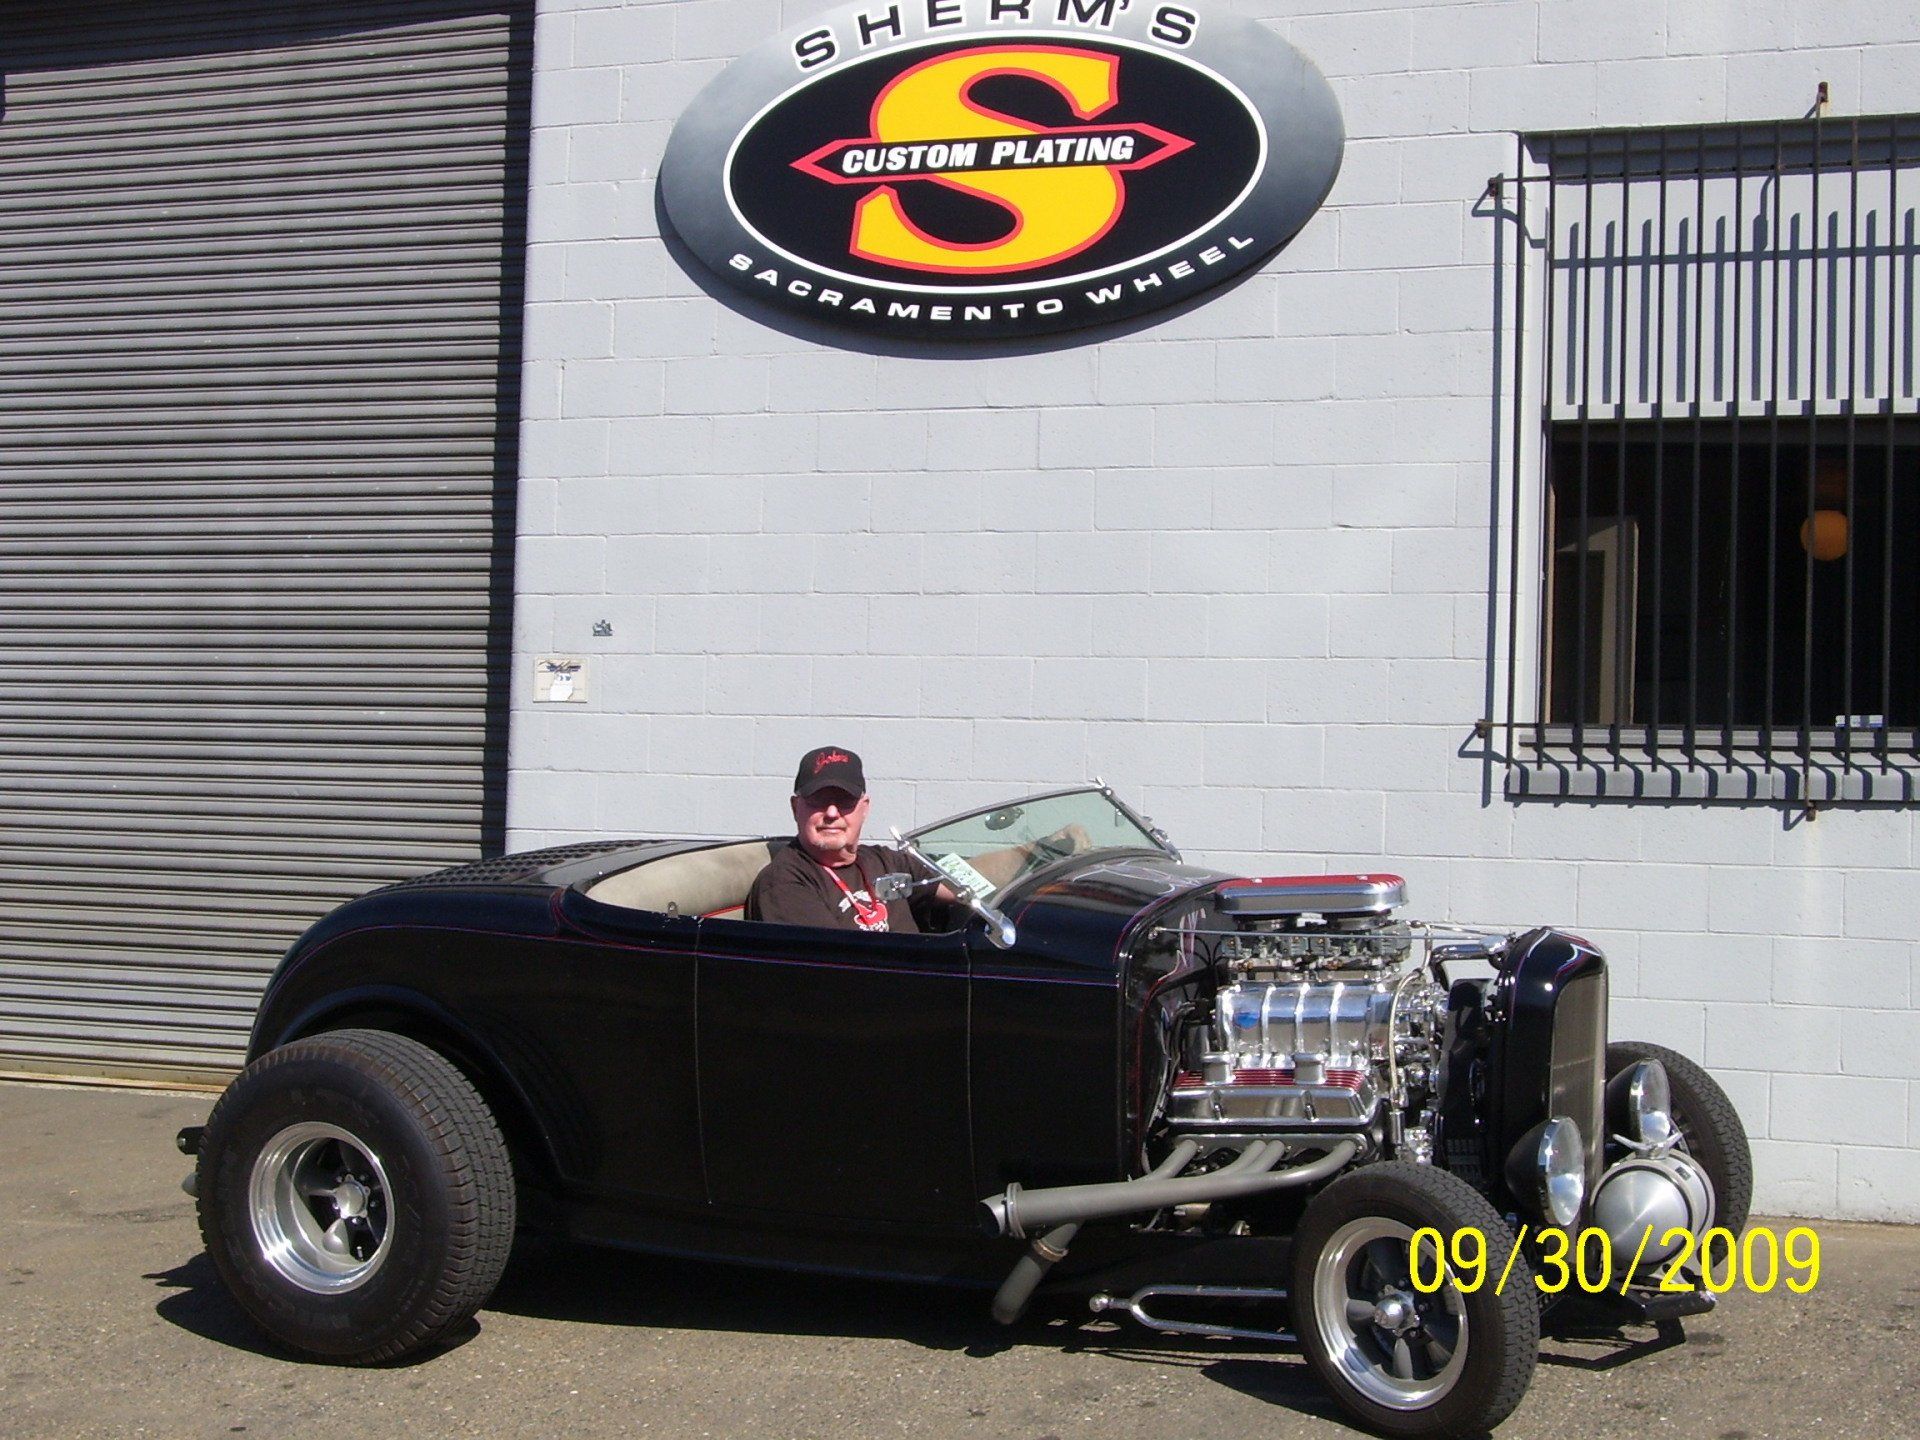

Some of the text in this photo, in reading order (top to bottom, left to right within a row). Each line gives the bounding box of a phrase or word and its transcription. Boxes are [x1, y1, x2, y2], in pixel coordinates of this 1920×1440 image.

[794, 0, 1198, 69] SHERM'S
[842, 135, 1136, 174] CUSTOM PLATING
[849, 45, 1126, 275] S
[729, 234, 1256, 322] SACRAMENTO WHEEL
